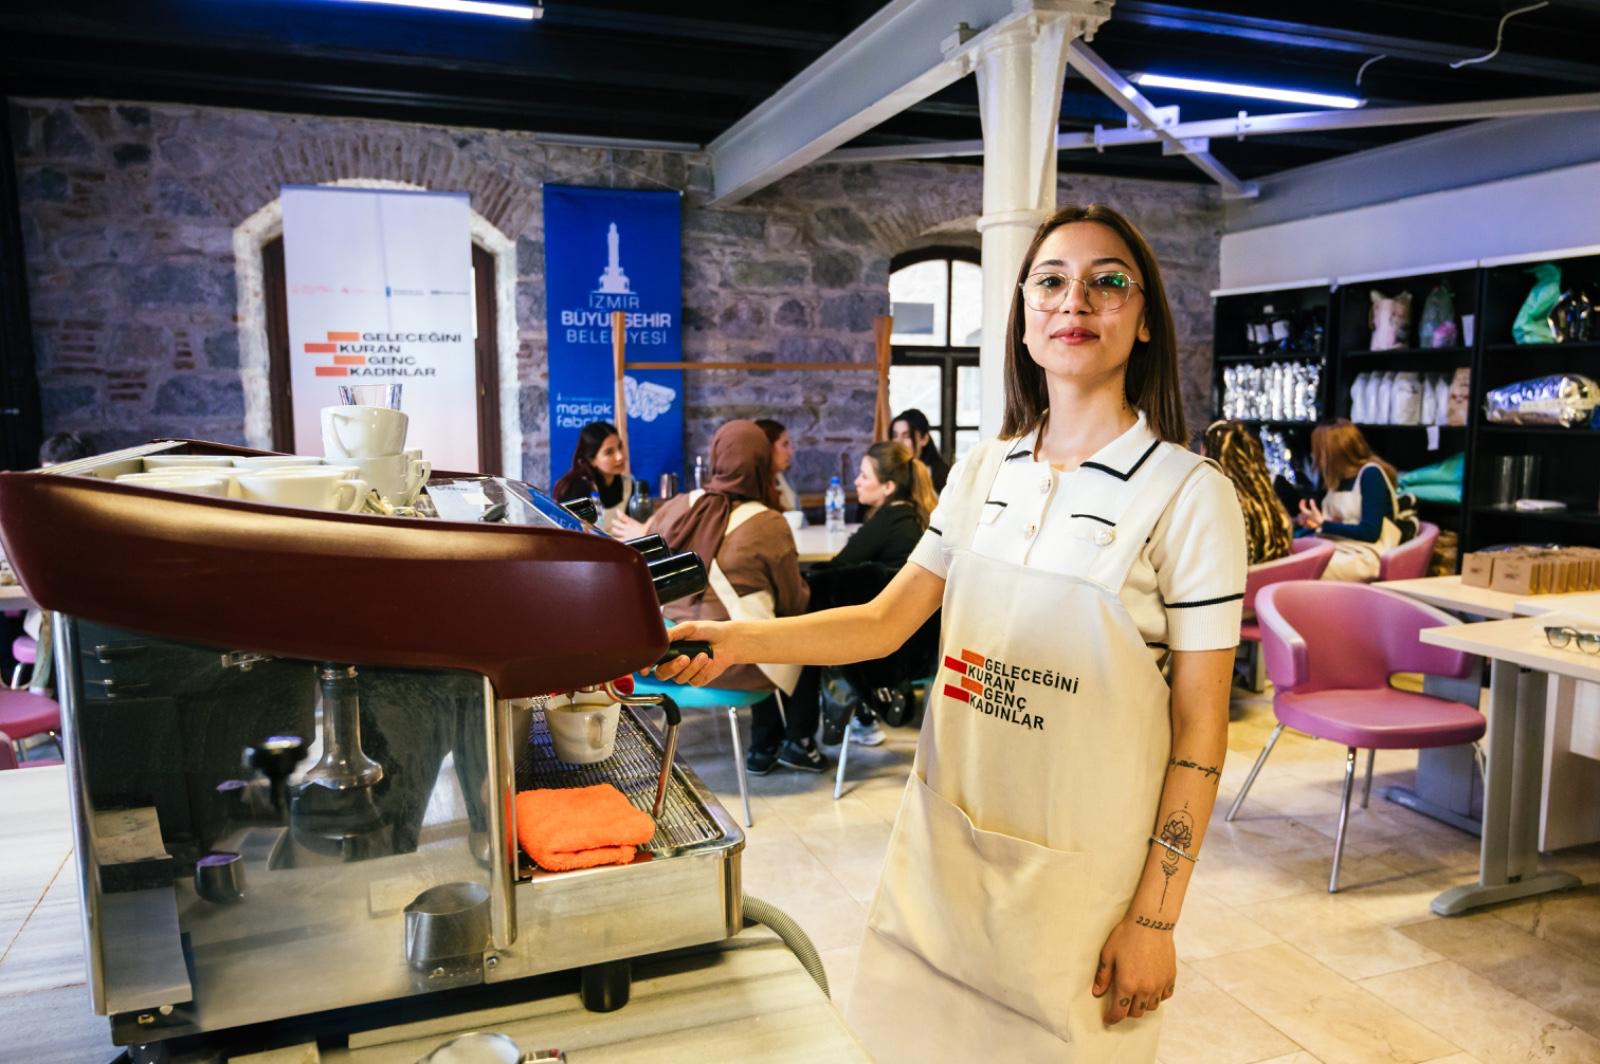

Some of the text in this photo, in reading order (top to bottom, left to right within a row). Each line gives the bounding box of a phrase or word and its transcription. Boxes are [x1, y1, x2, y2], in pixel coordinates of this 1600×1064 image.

[561, 307, 672, 329] BÜYÜŞEHİR
[339, 344, 402, 354] KURAN
[566, 329, 667, 345] BELEİYESİ
[350, 366, 436, 377] KADINLAR
[967, 664, 1015, 694] KURAN
[984, 657, 1079, 695] GELECEĞİNİ
[969, 693, 1044, 730] KADINLAR
[983, 687, 1027, 713] GENÇ
